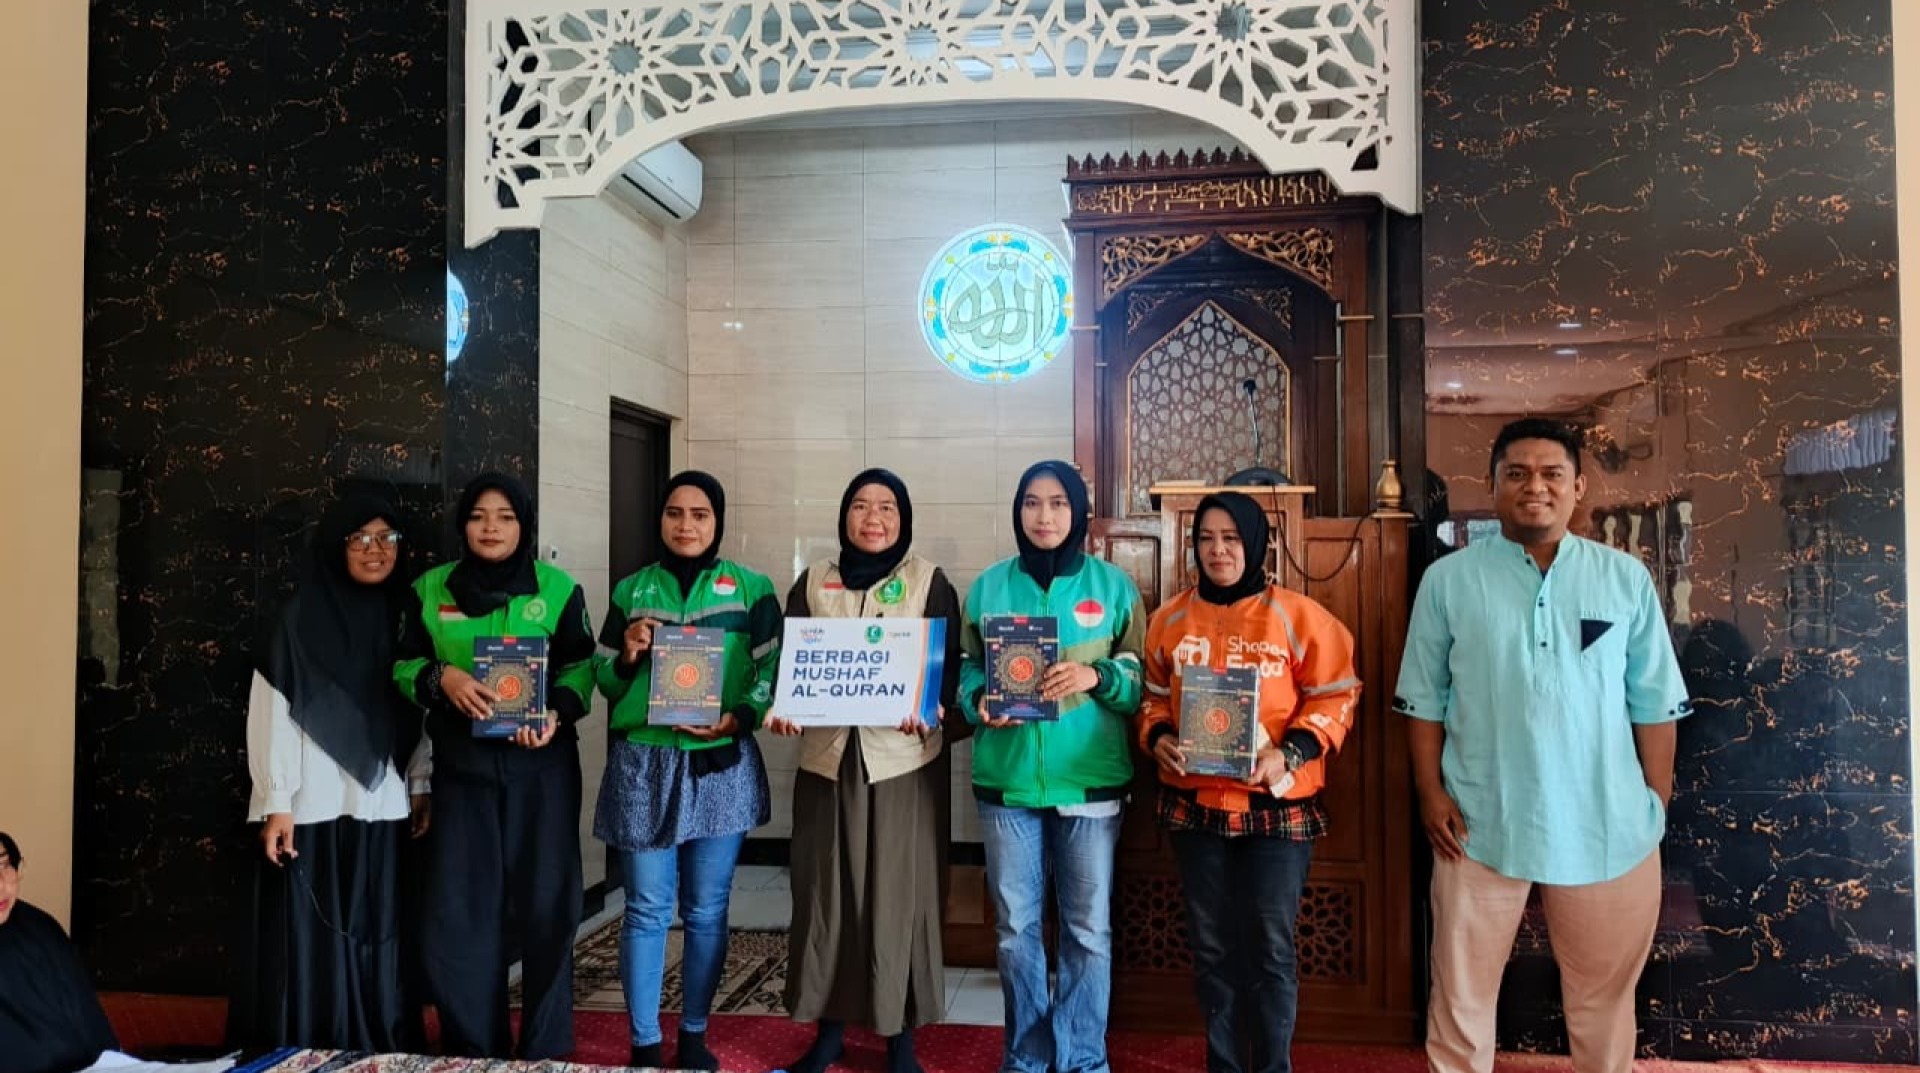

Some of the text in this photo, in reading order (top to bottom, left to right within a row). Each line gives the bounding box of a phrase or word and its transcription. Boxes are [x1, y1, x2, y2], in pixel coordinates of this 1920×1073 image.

[795, 650, 890, 664] BERBAGI
[793, 667, 882, 681] MUSHAF
[792, 683, 906, 697] AL-QURAN
